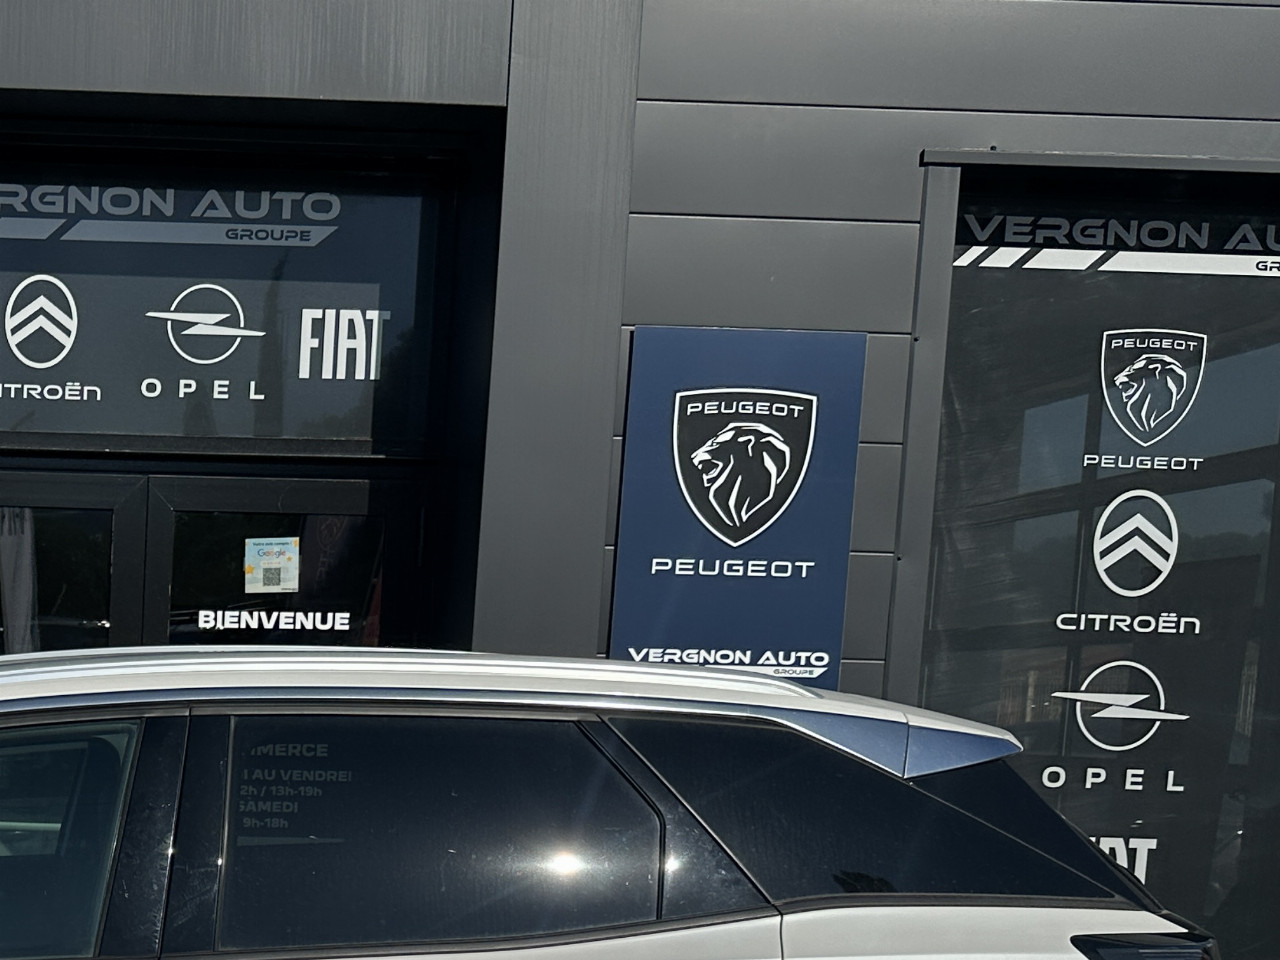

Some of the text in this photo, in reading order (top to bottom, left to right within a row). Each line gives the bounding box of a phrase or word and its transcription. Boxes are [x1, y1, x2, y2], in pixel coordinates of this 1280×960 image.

[190, 189, 342, 221] AUTO
[225, 228, 312, 242] GROUPE
[964, 214, 1210, 250] VERGNON
[298, 308, 391, 381] FIAT
[1111, 338, 1198, 352] PEUGEOT
[140, 378, 265, 400] OPEL
[686, 401, 804, 418] PEUGEOT
[1083, 454, 1204, 471] PEUGEOT
[257, 548, 286, 559] Google
[651, 558, 816, 578] PEUGEOT
[198, 610, 351, 631] BIENVENUE
[628, 647, 830, 667] VERGNON AUTO
[772, 668, 815, 676] GROUPE
[250, 743, 328, 757] MERCE
[1042, 766, 1185, 792] OPEL
